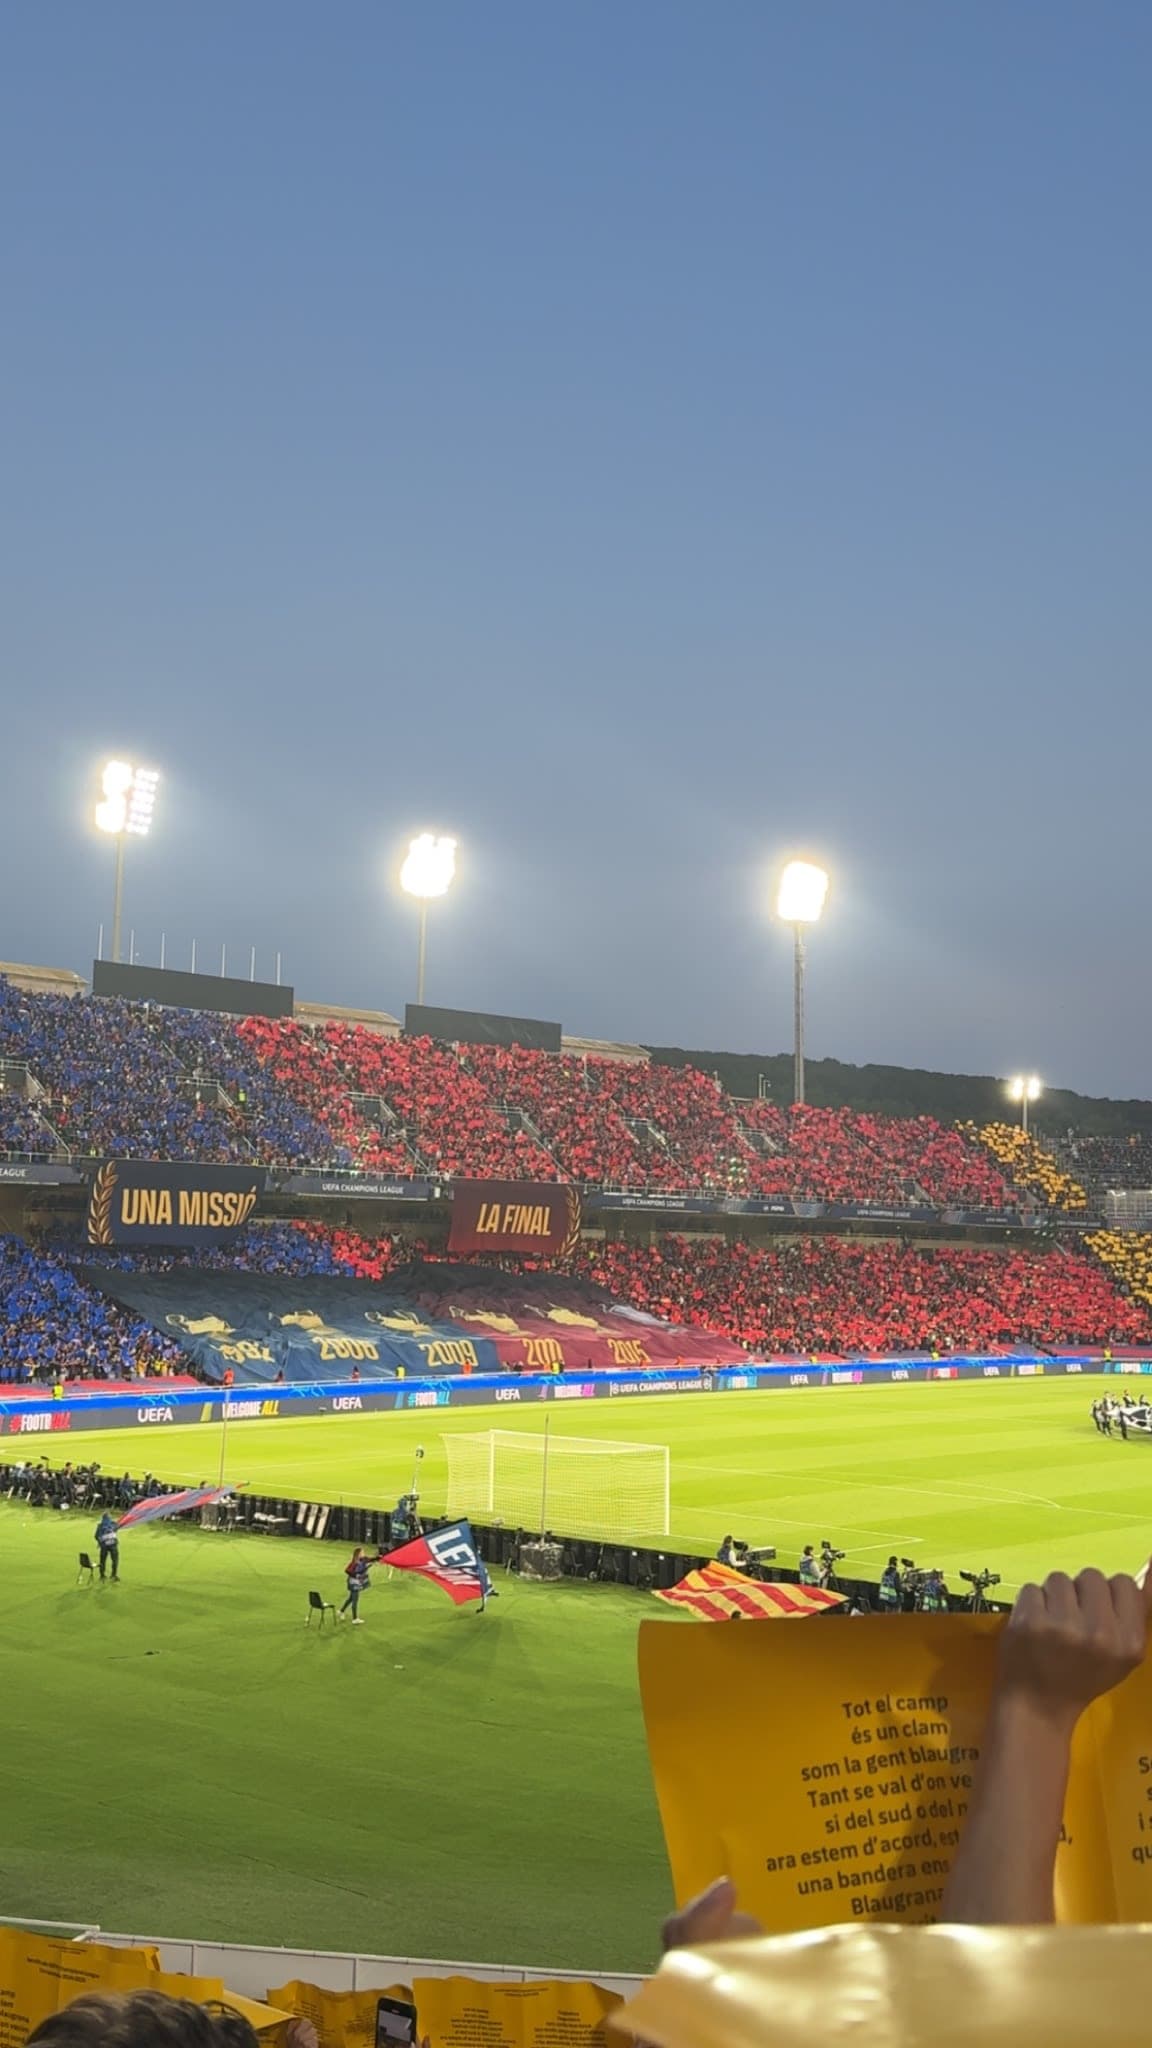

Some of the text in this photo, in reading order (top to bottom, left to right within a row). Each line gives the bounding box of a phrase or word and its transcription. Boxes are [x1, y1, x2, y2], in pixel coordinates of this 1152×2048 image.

[322, 1183, 404, 1194] UEFA CHAMPIONS LEAGUE
[121, 1188, 172, 1225] UNA
[476, 1203, 551, 1236] LA FINAL
[418, 1340, 479, 1367] 2009
[620, 1379, 702, 1393] UEFA CHAMPIONS LEAGUE
[790, 1374, 809, 1385] UEFA
[332, 1397, 363, 1410] UEFA
[495, 1388, 521, 1400] UEFA
[137, 1407, 173, 1423] UEFA
[842, 1694, 948, 1719] Tot el camp
[851, 1719, 948, 1745] és un clam
[801, 1761, 840, 1781] som
[844, 1756, 861, 1774] la
[866, 1750, 907, 1774] gent
[807, 1786, 849, 1808] Tant
[854, 1785, 874, 1801] se
[879, 1775, 907, 1796] val
[825, 1813, 840, 1834] si
[844, 1808, 874, 1830] del
[878, 1802, 912, 1825] sud
[916, 1805, 926, 1819] o
[928, 1798, 954, 1818] del
[766, 1854, 796, 1872] ara
[801, 1843, 859, 1866] estem
[863, 1827, 937, 1857] d'acord,
[797, 1877, 833, 1895] una
[838, 1862, 916, 1889] bandera
